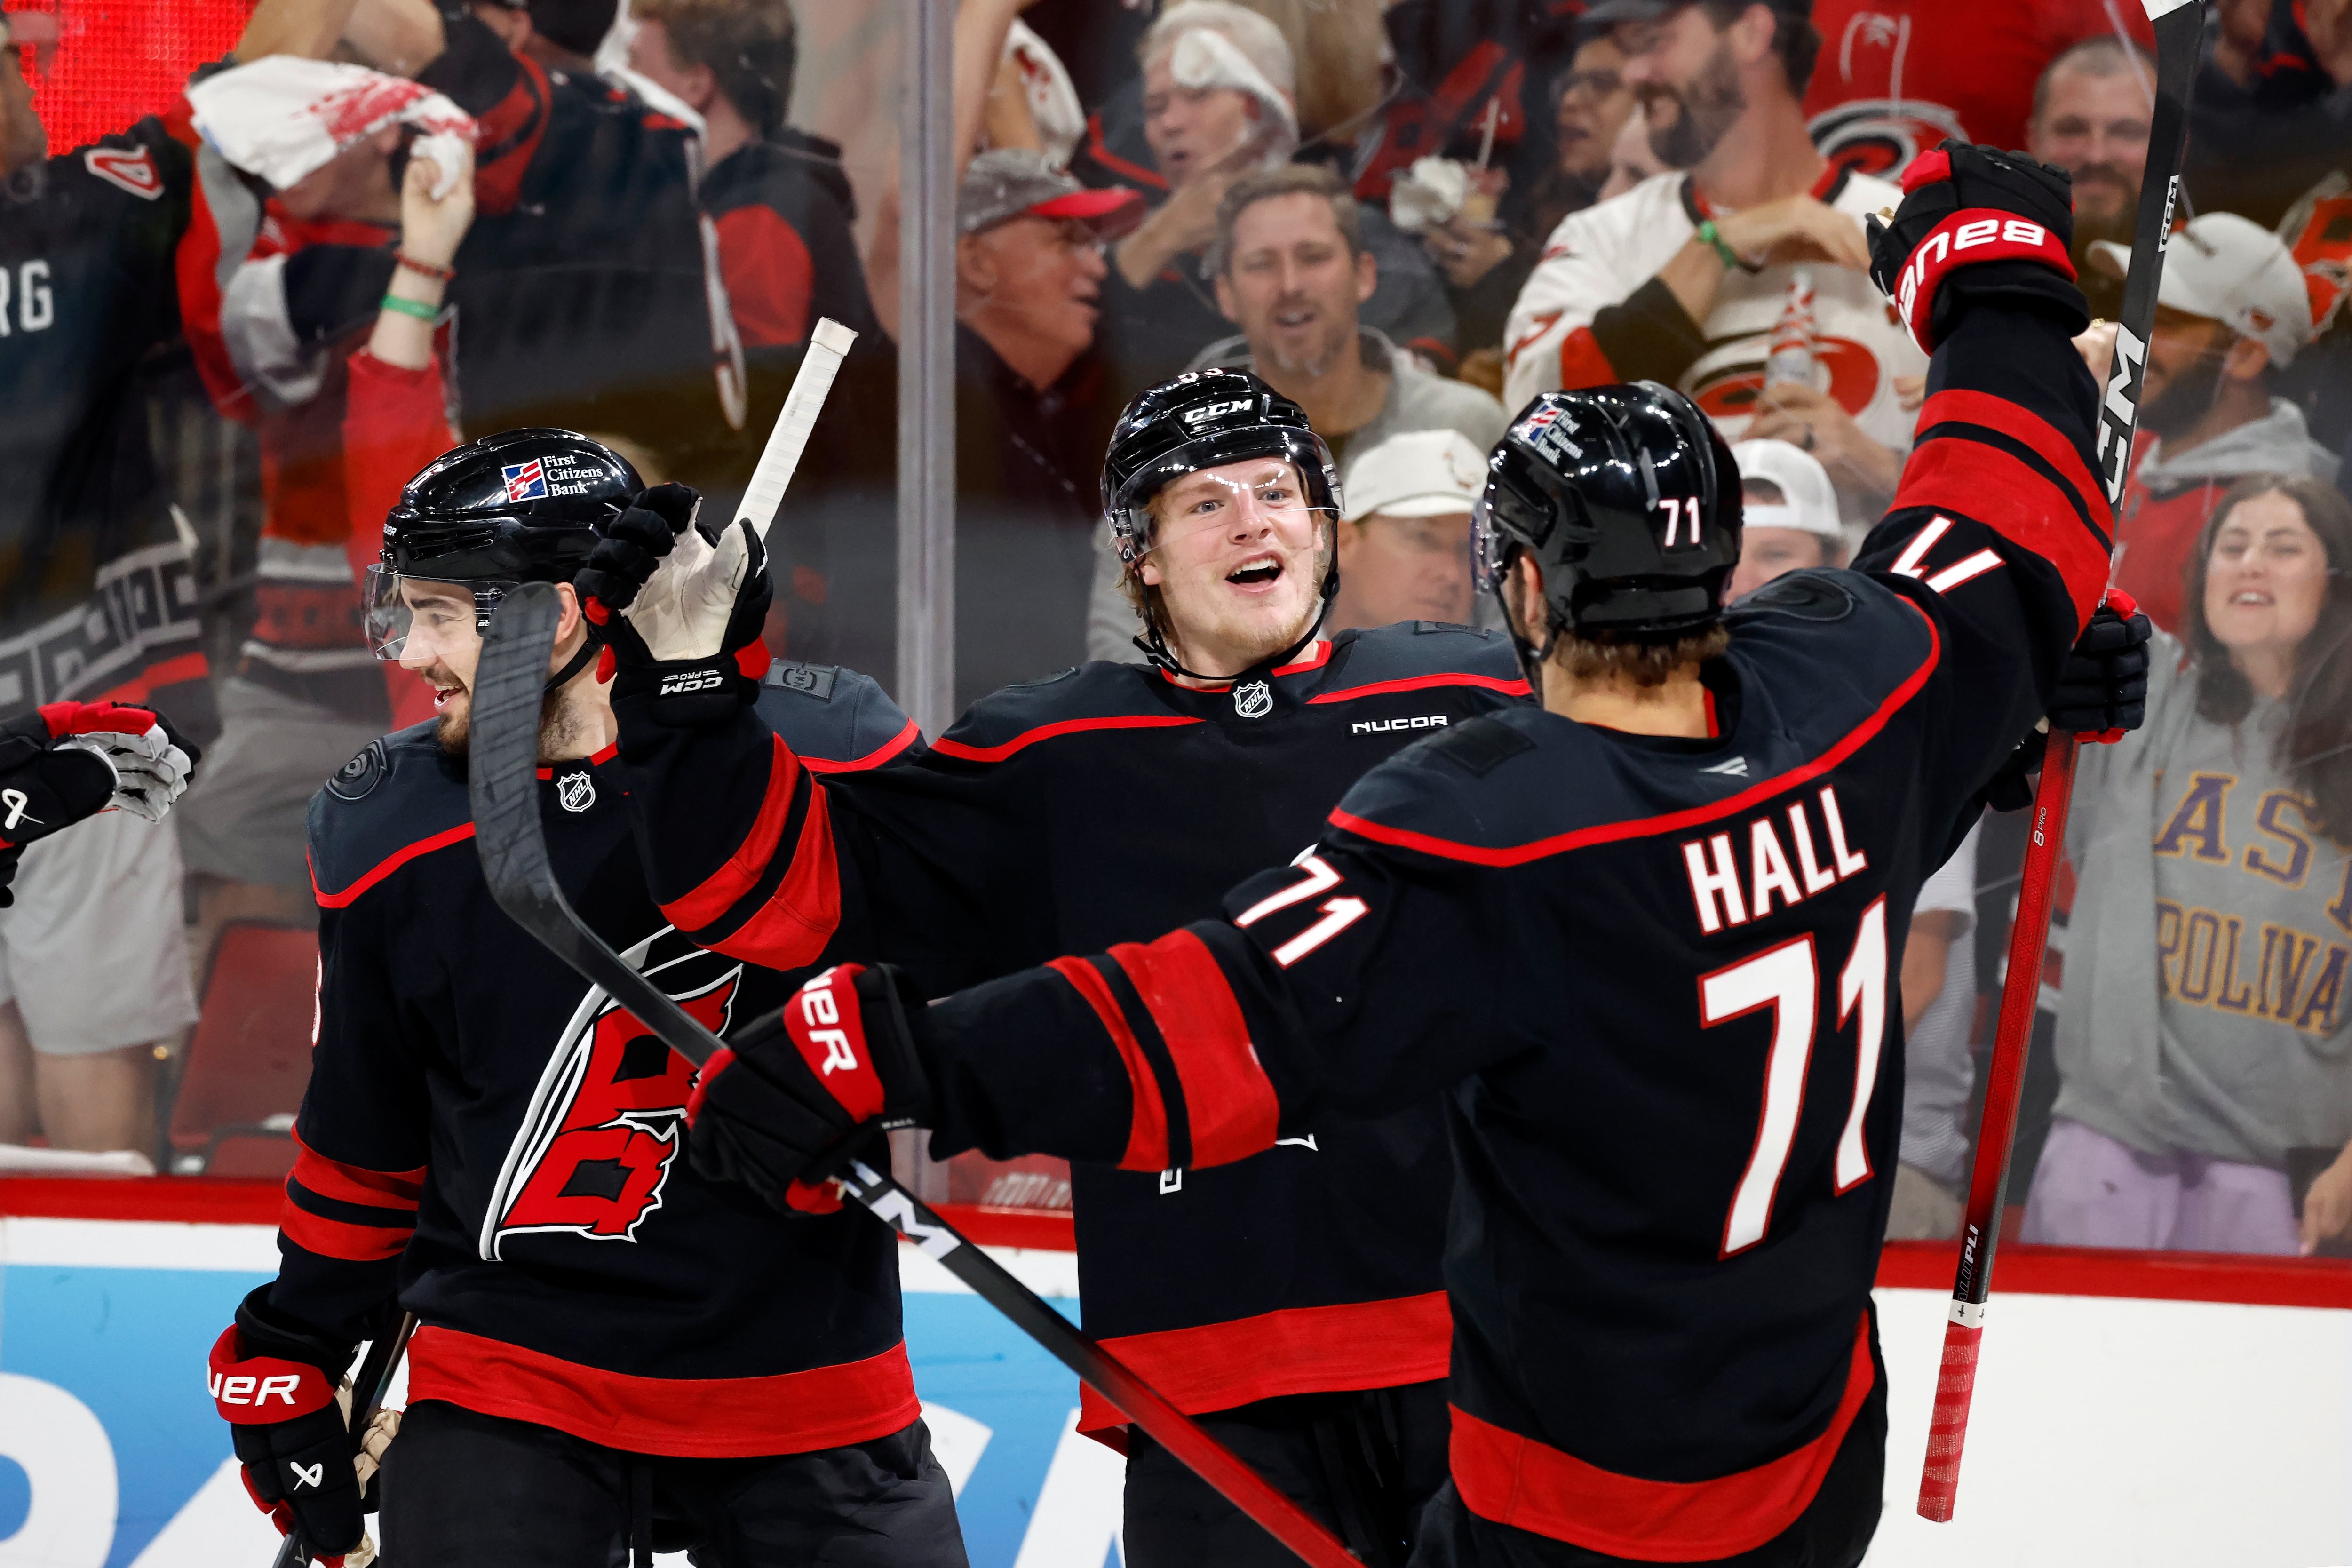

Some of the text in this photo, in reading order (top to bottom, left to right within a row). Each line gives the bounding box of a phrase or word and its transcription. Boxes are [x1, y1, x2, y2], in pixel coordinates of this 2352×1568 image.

[2160, 177, 2178, 250] CCM
[1899, 219, 2045, 358] BAUE
[1184, 399, 1253, 422] CCM
[542, 454, 577, 468] First
[547, 467, 604, 481] Citizens
[549, 480, 589, 497] Bank
[1658, 495, 1701, 548] 71
[660, 677, 723, 695] CCM
[679, 671, 702, 680] PRO
[1244, 692, 1263, 713] NHL
[1352, 716, 1448, 734] NUCOR
[568, 782, 586, 805] NHL
[2034, 807, 2047, 847] 8 PRO
[1680, 783, 1870, 936] HALL
[1233, 854, 1372, 971] 71
[1697, 892, 1889, 1262] 71
